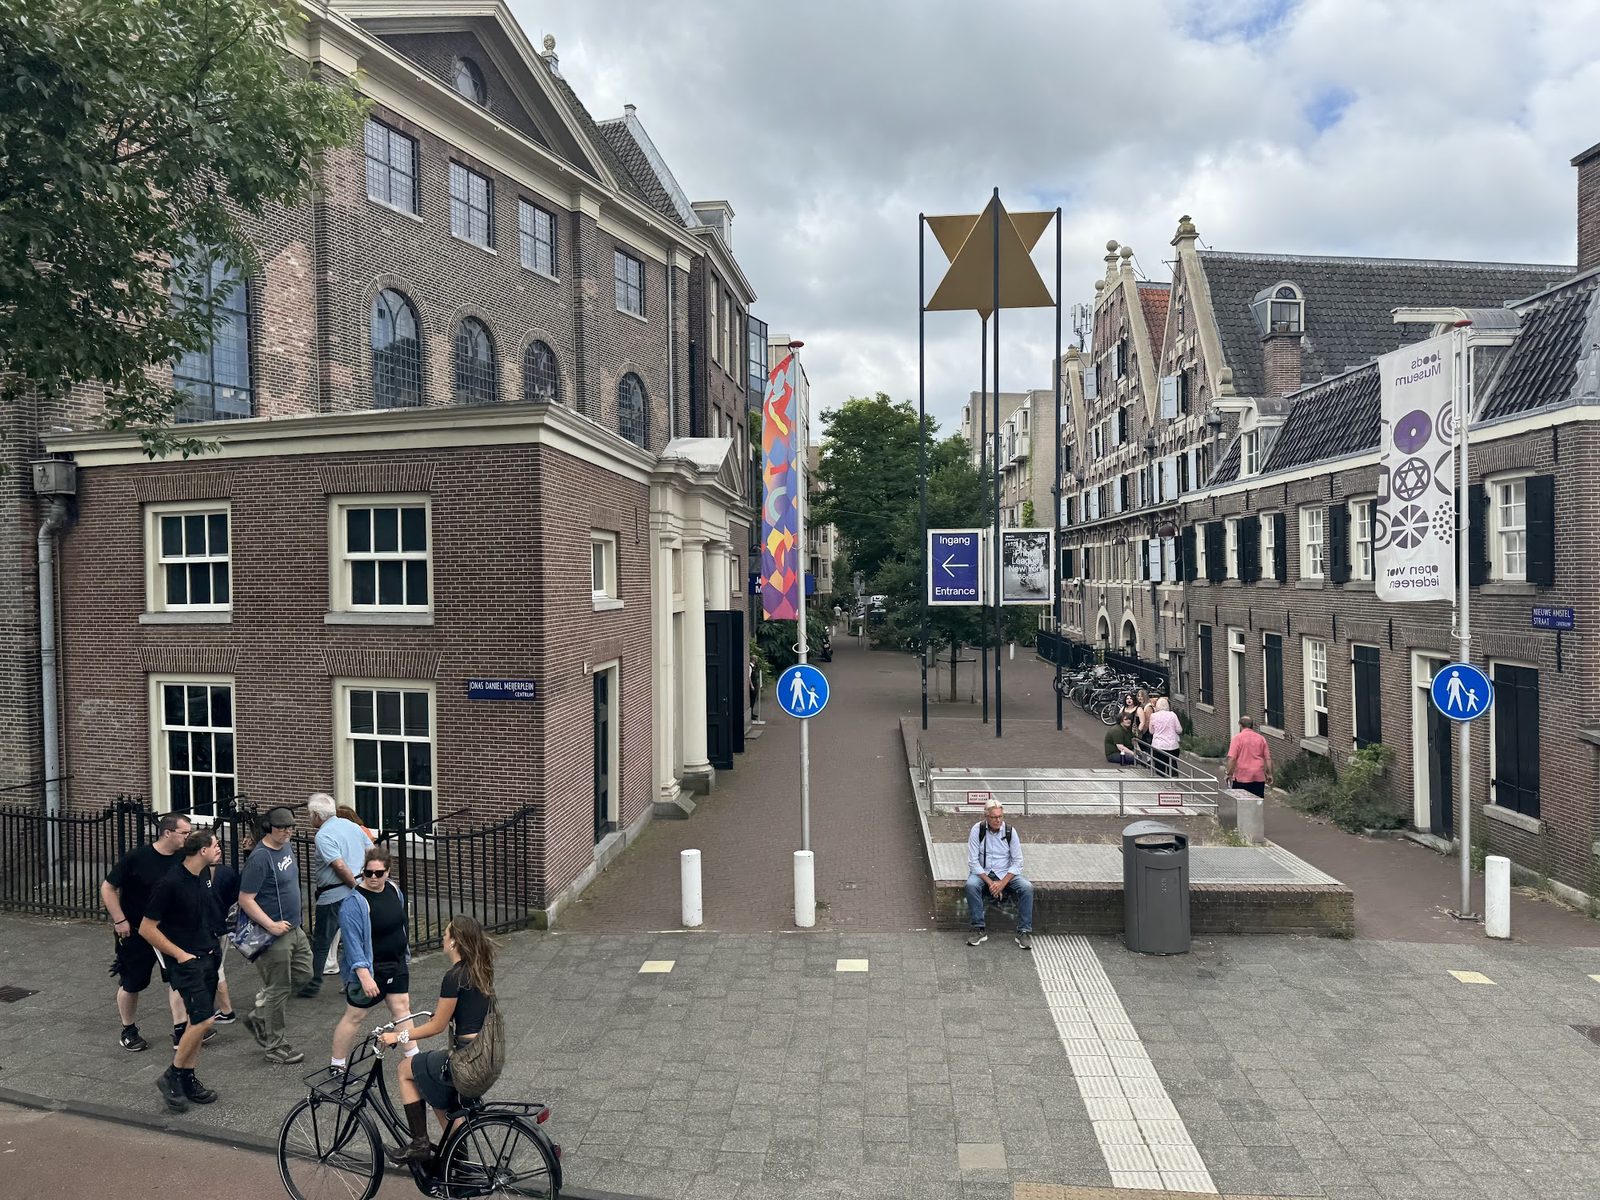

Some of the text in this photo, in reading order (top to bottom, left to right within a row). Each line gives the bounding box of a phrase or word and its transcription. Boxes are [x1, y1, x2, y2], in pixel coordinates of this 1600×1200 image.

[939, 536, 970, 546] Ingang
[935, 587, 975, 596] Entrance
[1533, 608, 1571, 618] NIEUWE AMSTEL
[1533, 617, 1549, 625] STRAAT
[469, 681, 484, 691] JONAS
[485, 681, 502, 690] DANIEL
